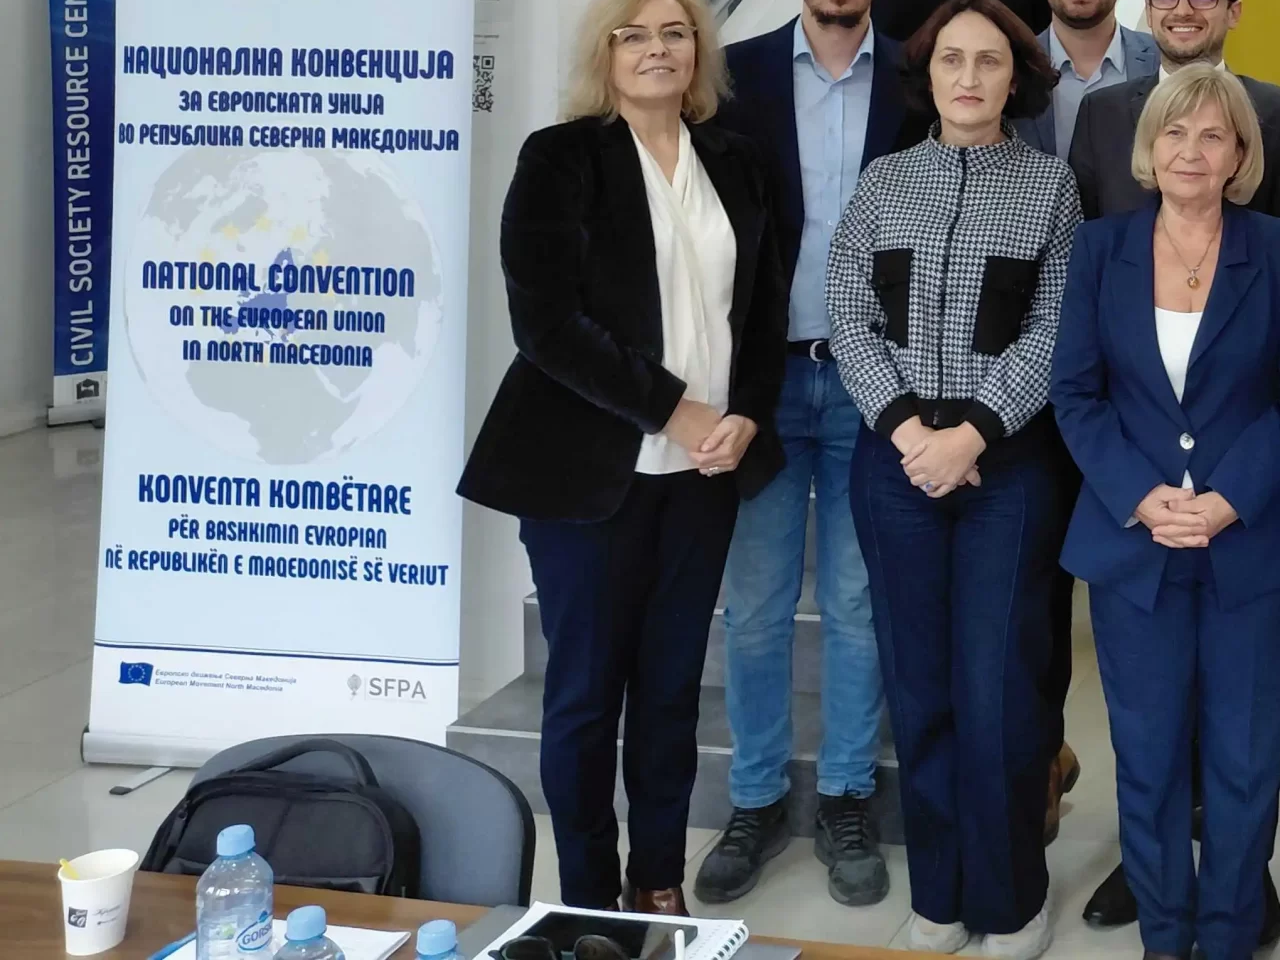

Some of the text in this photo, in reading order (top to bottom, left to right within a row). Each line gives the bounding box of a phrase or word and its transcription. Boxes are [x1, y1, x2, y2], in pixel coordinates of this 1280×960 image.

[123, 45, 454, 83] НАЦИОНАЛНА КОНВЕНЦИЈА
[65, 45, 92, 180] RESOURCE
[178, 90, 384, 115] ЗА ЕВРОПСКАТА УНИЈА
[118, 122, 459, 154] ВО РЕПУБЛИКА СЕВЕРНА МАКЕДОНИЈА
[68, 187, 93, 293] SOCIETY
[142, 260, 415, 297] NATIONAL CONVENTION
[71, 299, 94, 367] CIVIL
[169, 304, 386, 333] ON THE EUROPEAN UNION
[182, 339, 373, 367] IN NORTH MACEDONIA
[138, 473, 412, 515] KONVENTA KOMBËTARE
[168, 513, 387, 550] PËR BASHKIMIN EVROPIAN
[105, 544, 449, 586] NË REPUBLIKËN E MAQEDONISË SË VERIUT
[369, 677, 427, 699] SFPA
